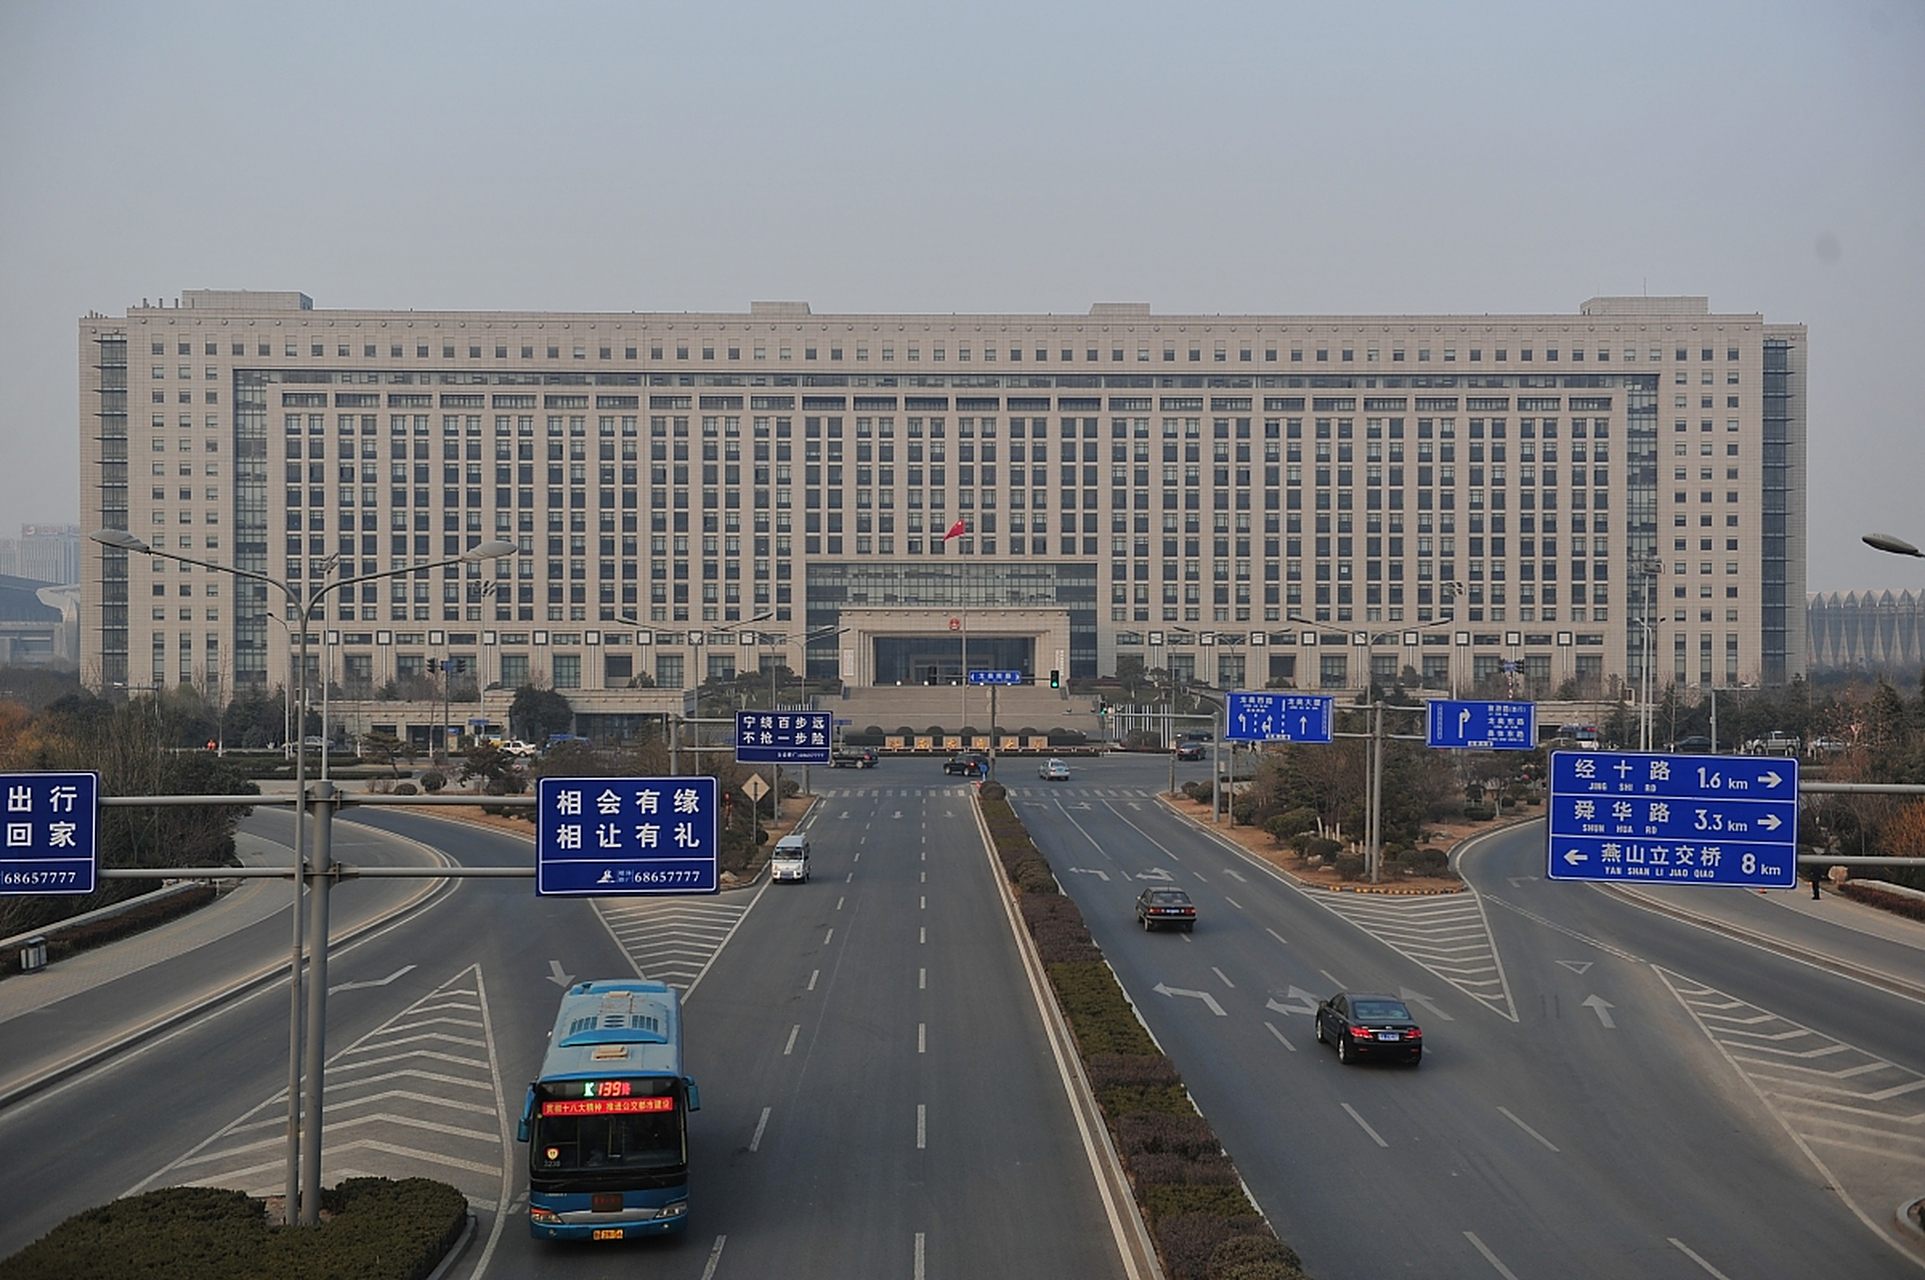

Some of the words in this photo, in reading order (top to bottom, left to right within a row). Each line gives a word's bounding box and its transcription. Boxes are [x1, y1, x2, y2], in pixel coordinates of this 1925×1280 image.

[743, 716, 825, 729] 宁绕百步远
[743, 731, 825, 745] 不抢一步险
[1575, 759, 1670, 781] 经十路
[1697, 768, 1721, 789] 1.6
[1729, 778, 1748, 790] km
[1588, 782, 1607, 791] JING
[1619, 783, 1633, 792] SHI
[1645, 784, 1657, 793] RD
[7, 786, 77, 812] 出行
[557, 789, 700, 815] 相会有缘
[1575, 800, 1670, 823] 舜华路
[1695, 810, 1723, 831] 3.3
[1728, 820, 1748, 832] km
[7, 821, 76, 847] 回家
[557, 823, 700, 849] 相让有礼
[1582, 824, 1605, 833] SHUN
[1616, 825, 1634, 834] HUA
[1645, 826, 1657, 835] RD
[1602, 843, 1722, 866] 燕山立交桥
[1741, 853, 1756, 875] 8
[1761, 864, 1781, 876] km
[4, 872, 76, 884] 68657777
[634, 870, 700, 883] 68657777
[1605, 866, 1622, 875] YAN
[1627, 867, 1650, 876] SHAN
[1655, 868, 1664, 877] LI
[1669, 869, 1689, 877] JIAO
[1693, 870, 1714, 879] QIAO
